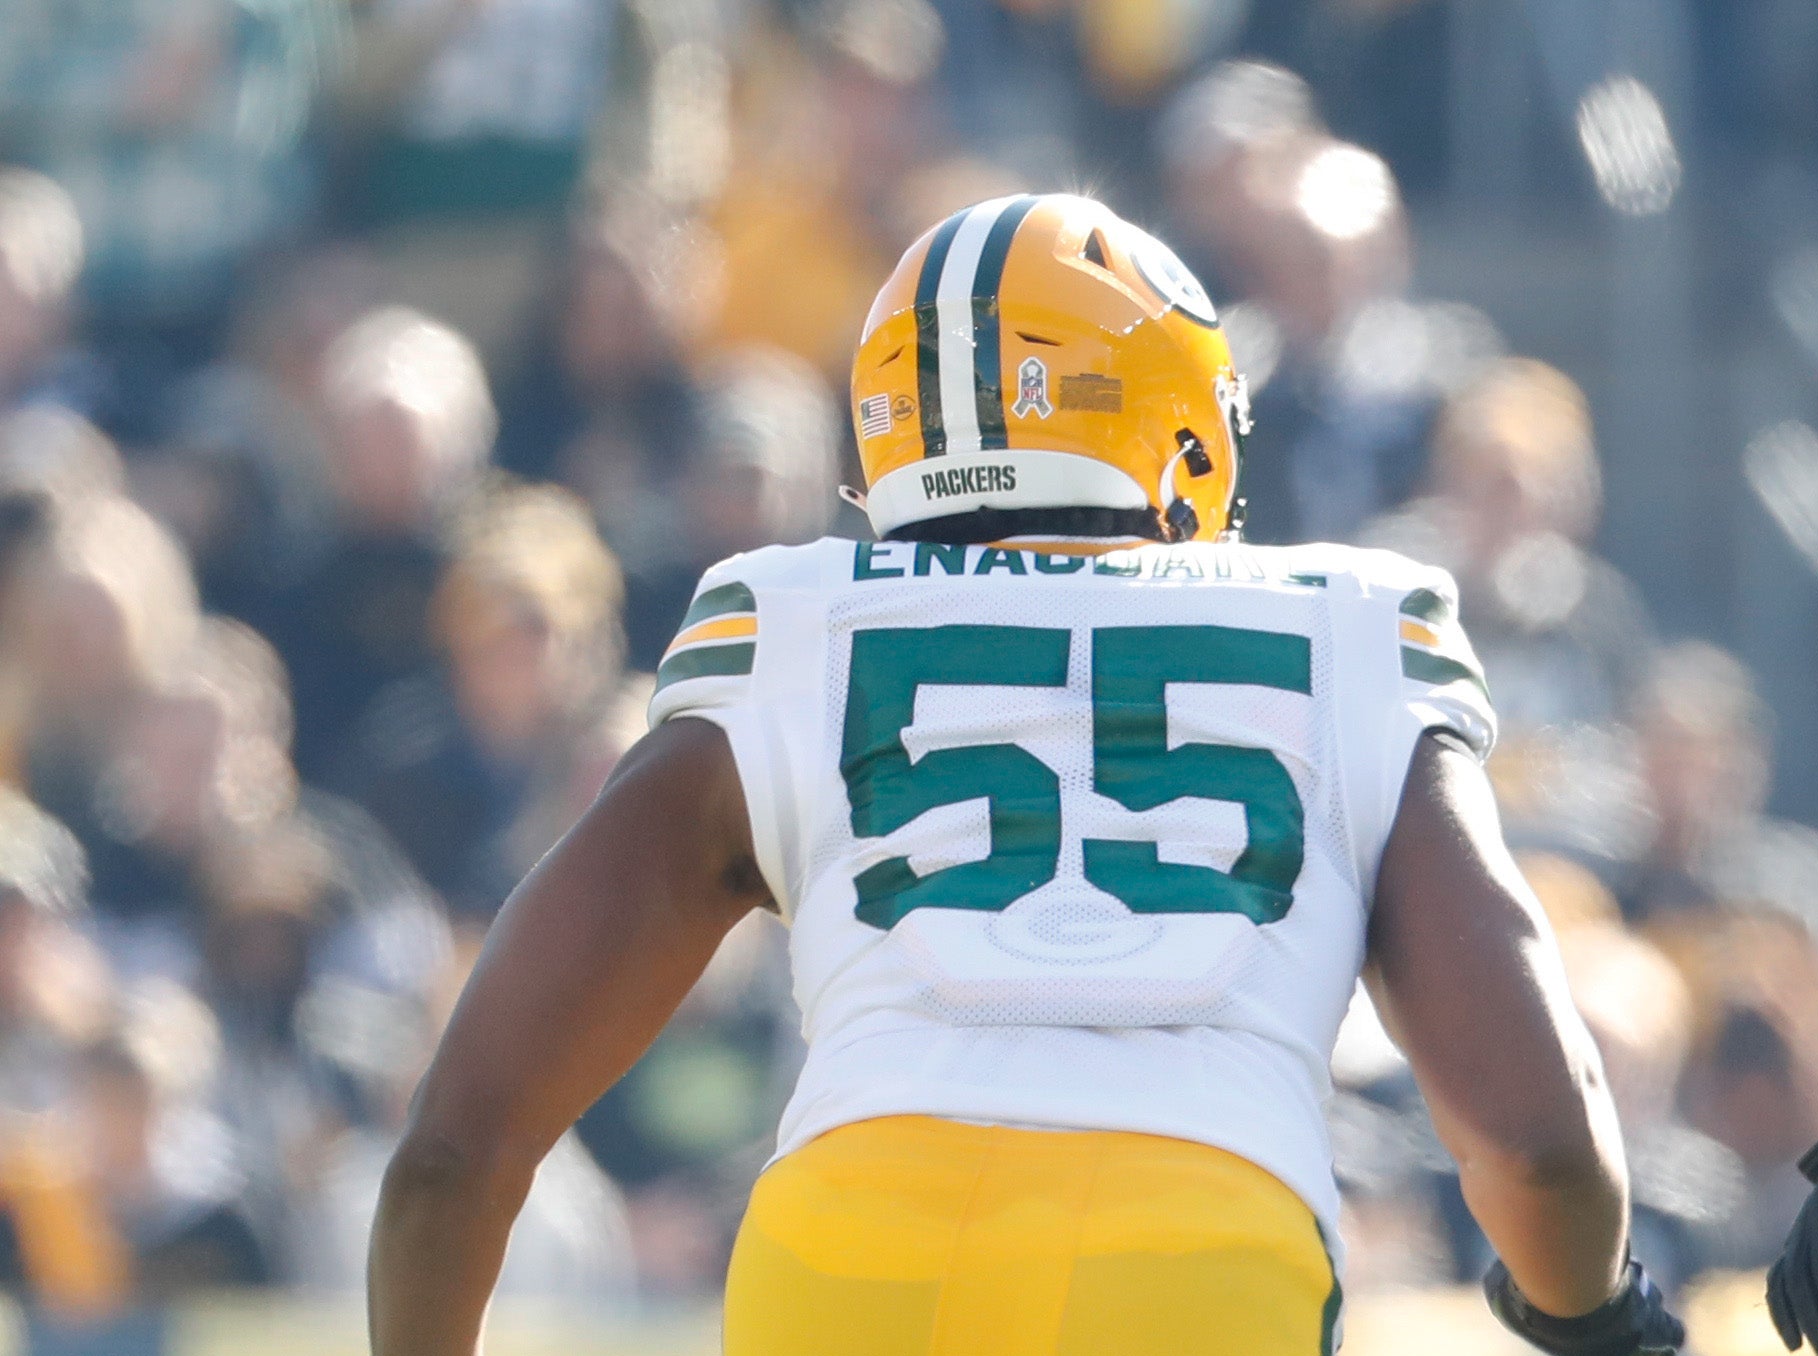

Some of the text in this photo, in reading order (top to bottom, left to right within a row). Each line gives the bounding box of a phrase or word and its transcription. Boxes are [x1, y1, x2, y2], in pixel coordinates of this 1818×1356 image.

[1022, 387, 1043, 402] NFL
[921, 464, 1017, 500] PACKERS
[840, 623, 1314, 931] 55
